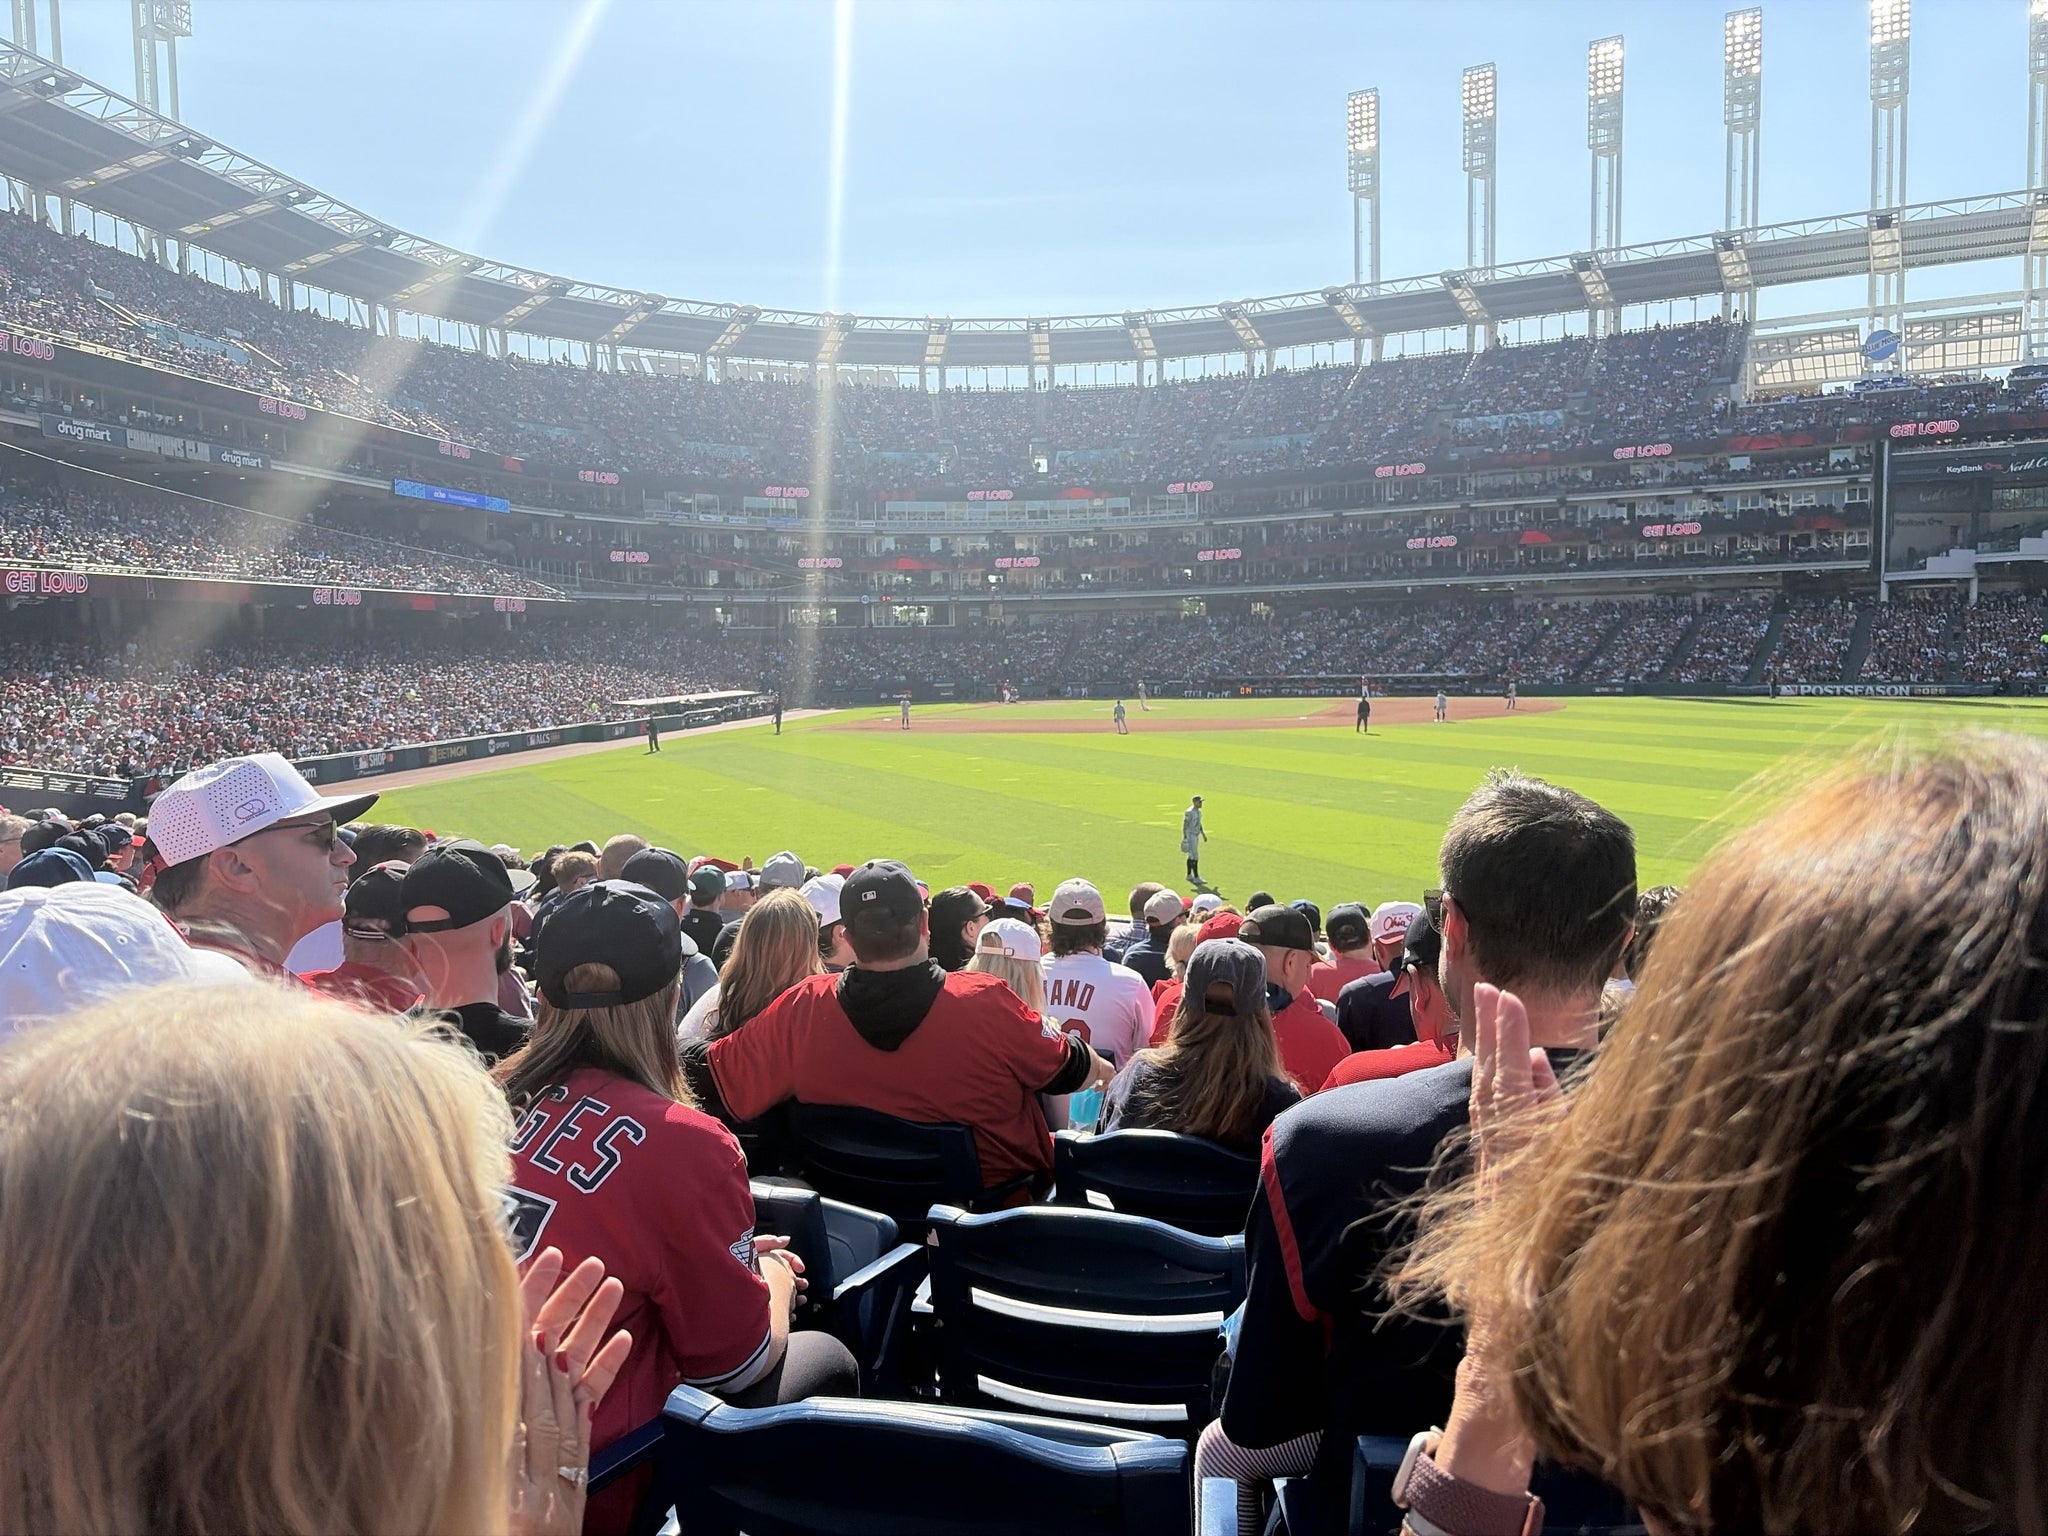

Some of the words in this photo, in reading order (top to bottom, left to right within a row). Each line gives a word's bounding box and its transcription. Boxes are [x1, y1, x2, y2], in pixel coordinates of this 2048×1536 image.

[13, 335, 54, 360] LOUD
[1881, 335, 1901, 346] MOON
[259, 396, 277, 414] GET
[279, 399, 306, 420] LOUD
[58, 421, 84, 440] drug
[85, 427, 111, 442] mart
[1890, 423, 1916, 438] GET
[1918, 419, 1960, 435] LOUD
[452, 443, 471, 459] LOUD
[1613, 447, 1636, 459] GET
[1637, 443, 1672, 457] LOUD
[221, 451, 241, 467] drug
[242, 455, 262, 469] mart
[1375, 465, 1394, 477] GET
[1395, 462, 1426, 475] LOUD
[1946, 465, 1983, 473] KeyBank
[596, 472, 619, 485] LOUD
[783, 487, 809, 497] LOUD
[1186, 481, 1213, 493] LOUD
[986, 490, 1013, 500] LOUD
[1642, 525, 1665, 537] GET
[1666, 522, 1702, 535] LOUD
[1406, 538, 1425, 549] GET
[1427, 535, 1457, 548] LOUD
[625, 552, 649, 563] LOUD
[1215, 548, 1242, 559] LOUD
[816, 558, 843, 568] LOUD
[1013, 557, 1040, 567] LOUD
[6, 571, 36, 592] GET
[41, 572, 88, 593] LOUD
[313, 588, 332, 604] GET
[333, 589, 361, 606] LOUD
[507, 599, 526, 612] LOUD
[1800, 685, 1909, 696] POSTSEASON
[369, 752, 386, 767] SHOP
[1043, 979, 1095, 1012] AND
